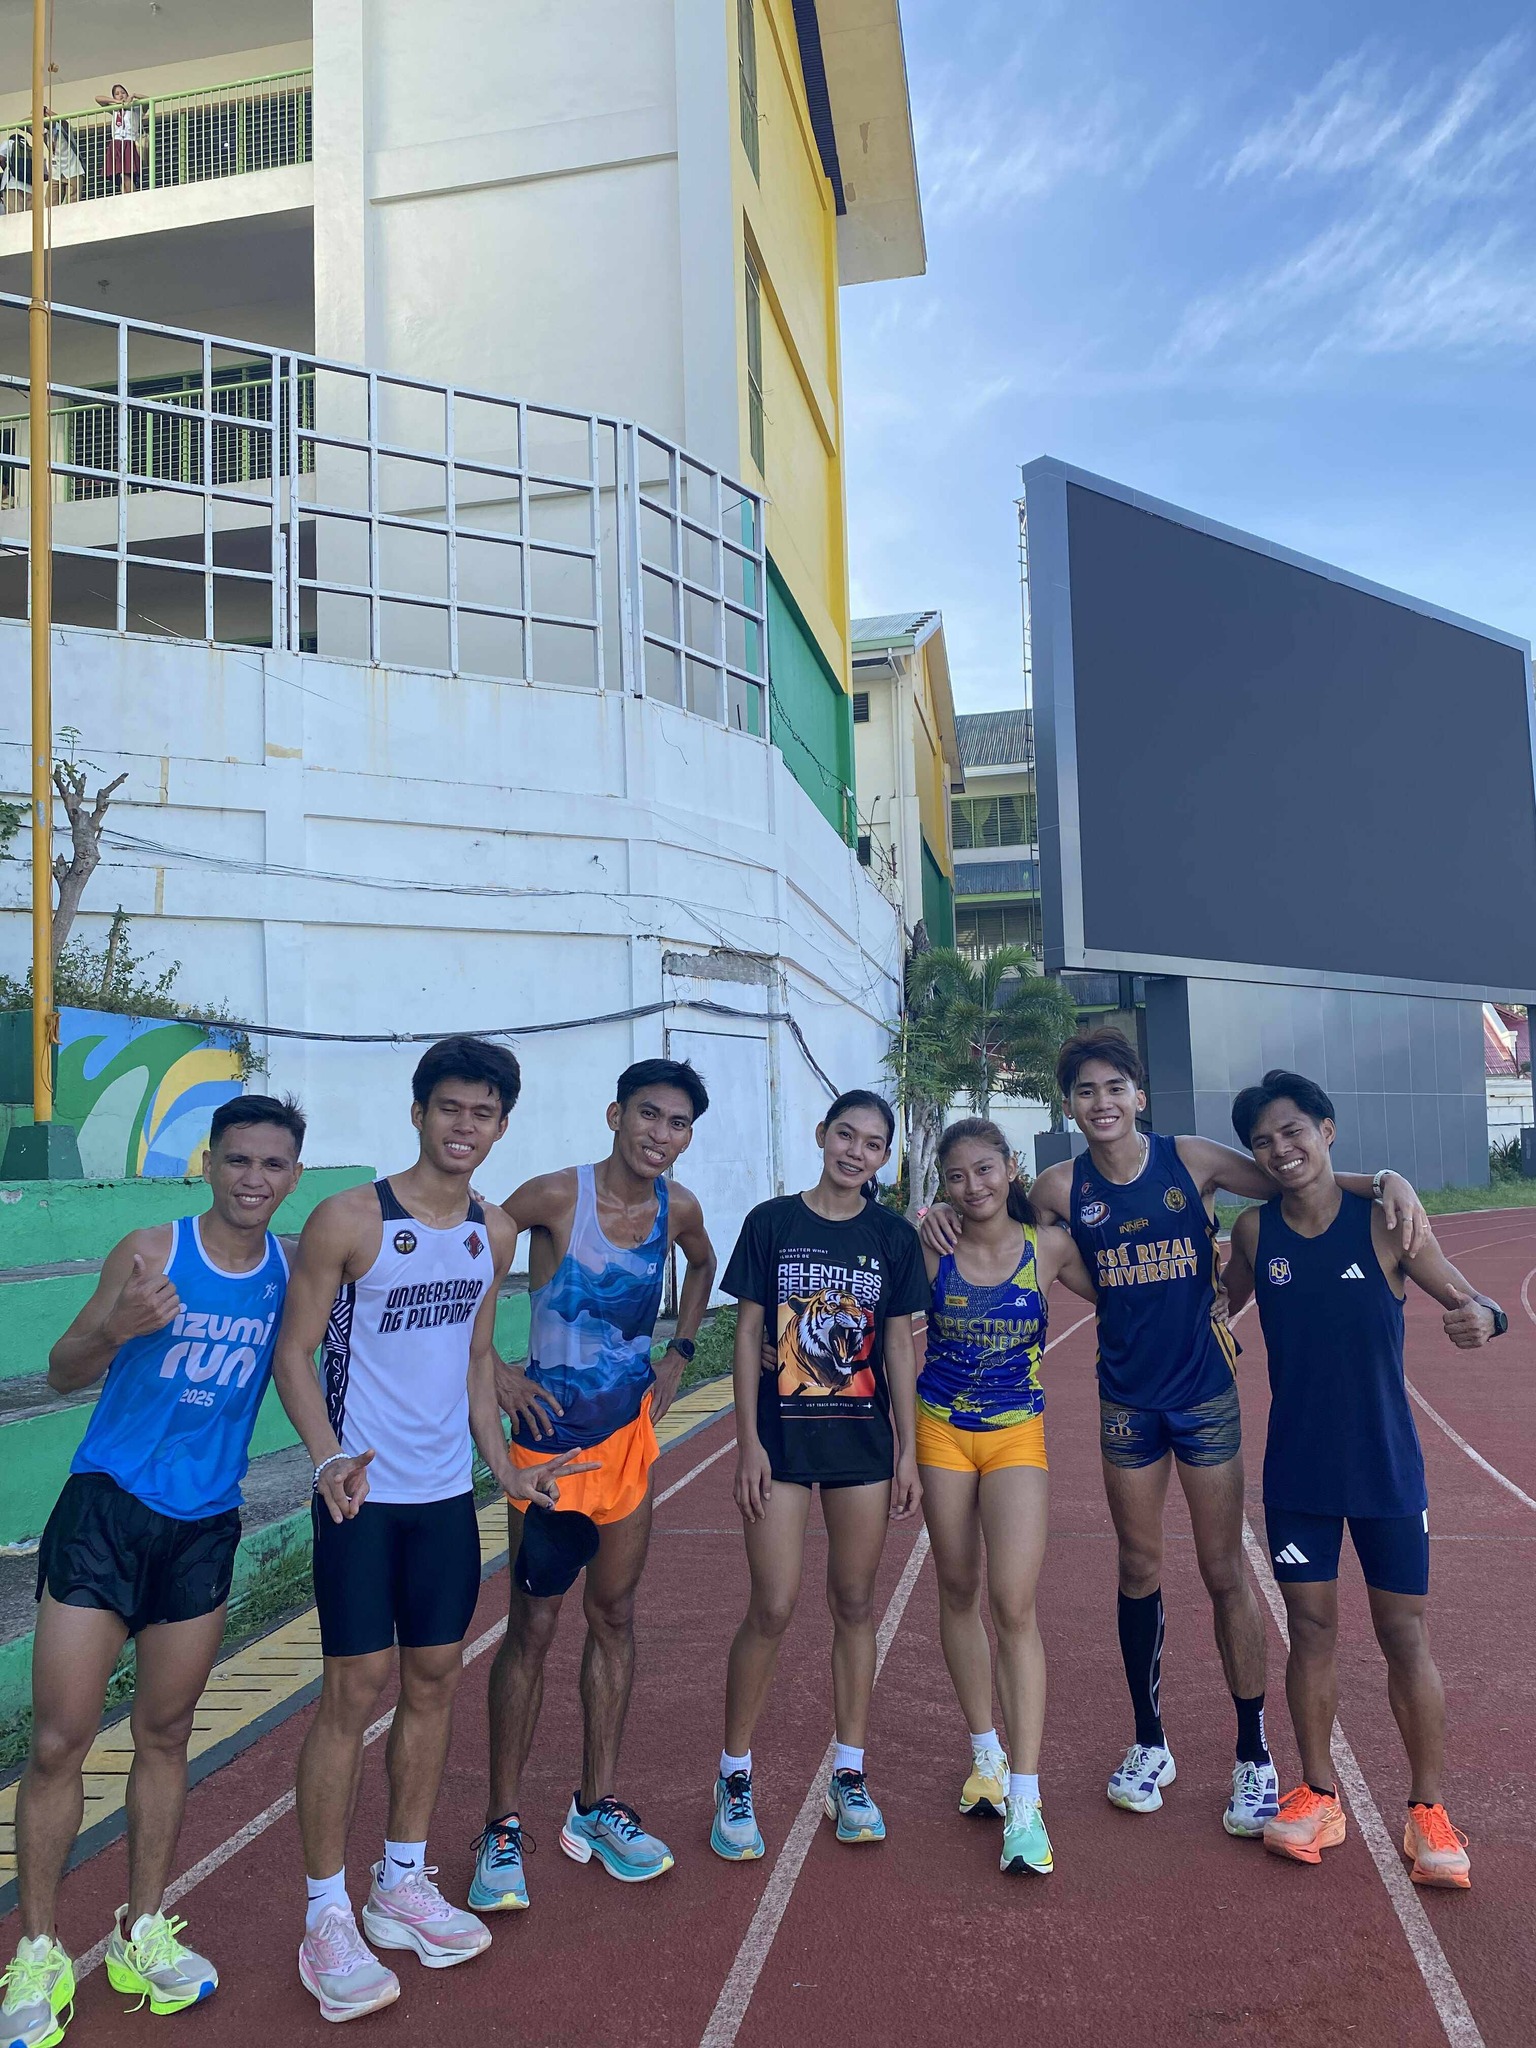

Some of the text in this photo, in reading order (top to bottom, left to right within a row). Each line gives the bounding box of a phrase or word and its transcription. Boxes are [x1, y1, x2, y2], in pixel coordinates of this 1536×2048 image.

[1119, 1218, 1150, 1234] INNER
[1094, 1237, 1197, 1269] OSÉ RIZAL
[777, 1263, 882, 1289] RELENTLESS
[1099, 1256, 1198, 1287] UNIVERSITY
[386, 1279, 484, 1309] UNIBERSIDAD
[171, 1302, 276, 1346] izumi
[378, 1310, 404, 1334] NG
[933, 1312, 1040, 1336] SPECTRUM
[159, 1340, 257, 1388] run
[178, 1387, 216, 1408] 2025
